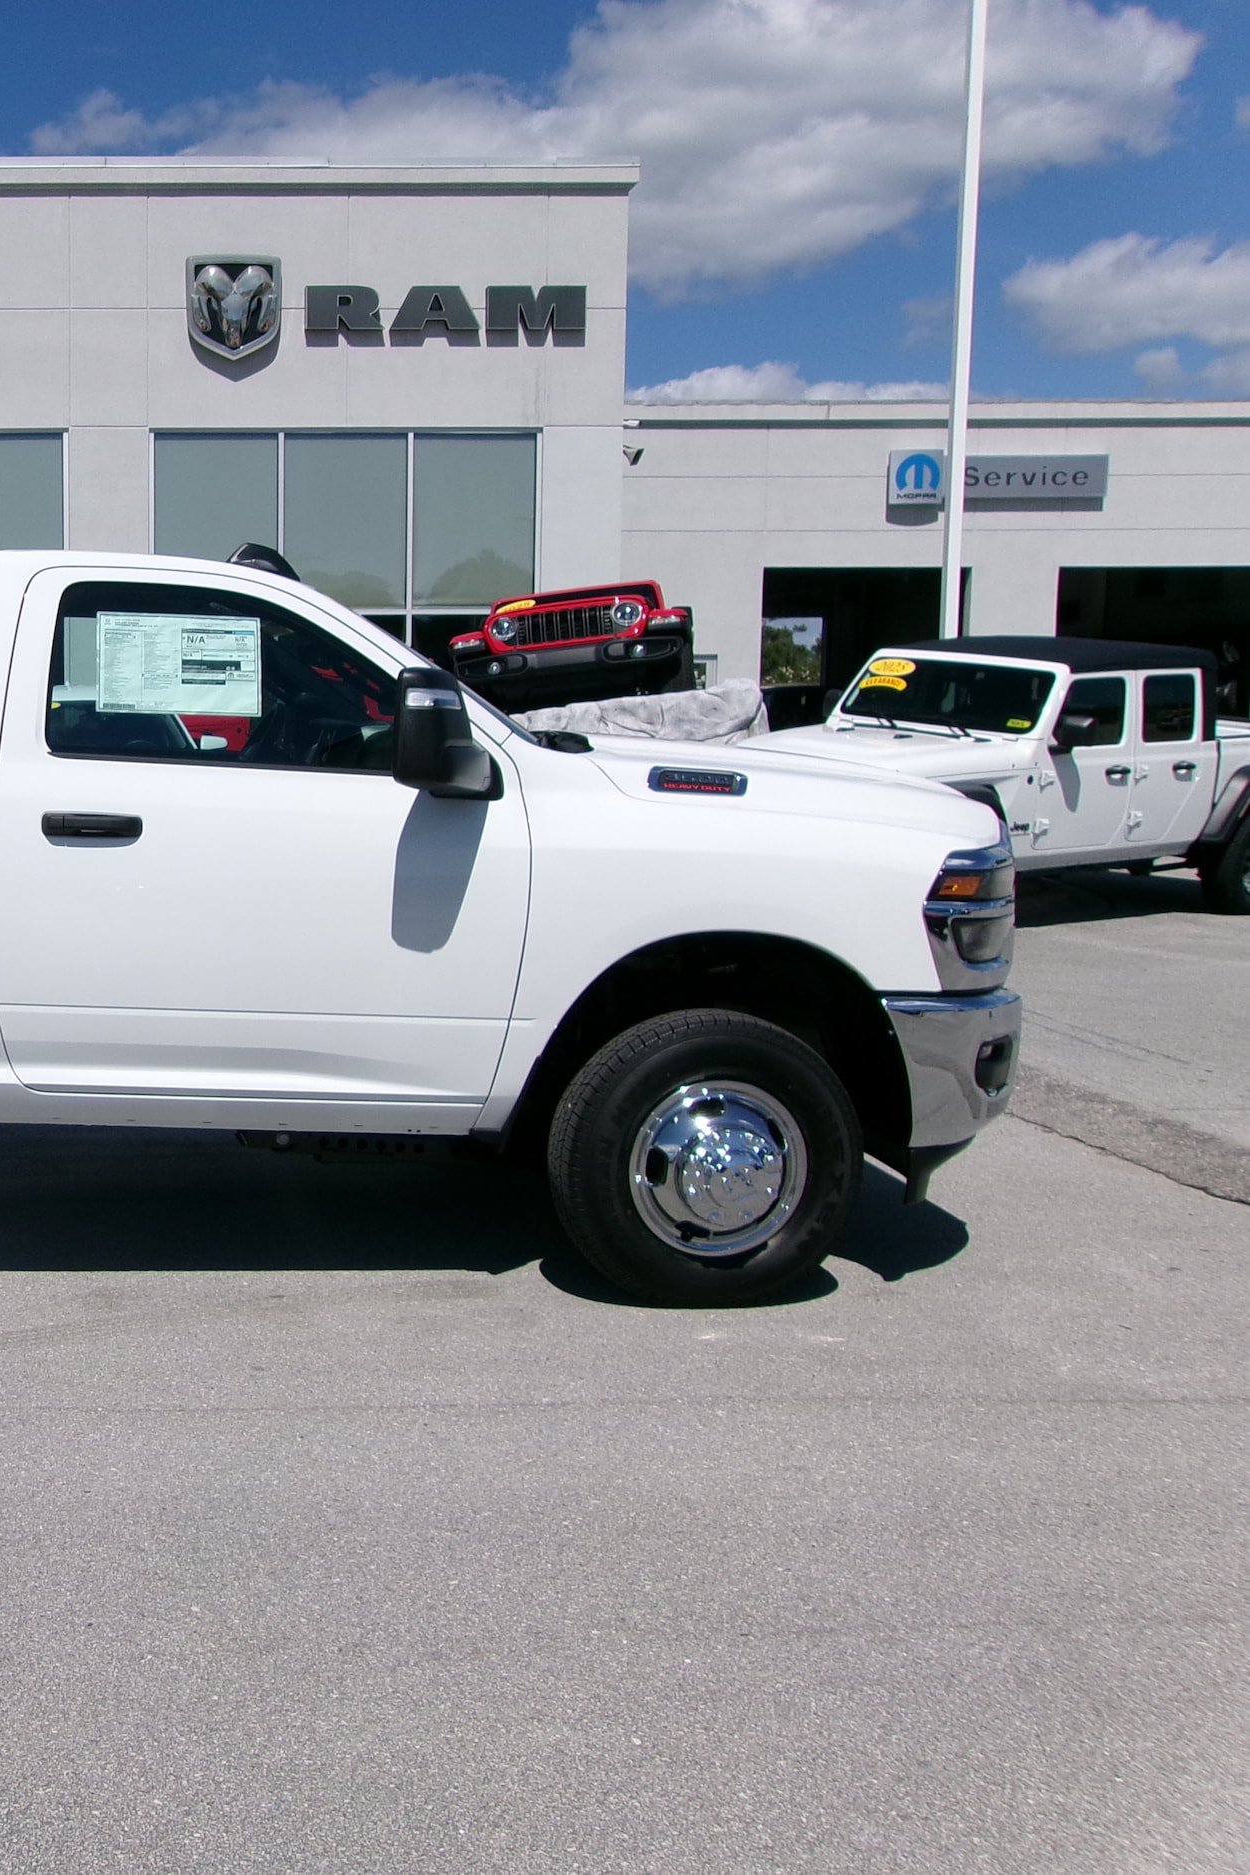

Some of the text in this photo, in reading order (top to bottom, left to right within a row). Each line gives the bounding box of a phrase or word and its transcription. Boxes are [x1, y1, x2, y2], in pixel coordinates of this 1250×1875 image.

[304, 284, 588, 330] RAM
[964, 466, 1089, 487] Service
[187, 635, 206, 644] N/A
[1010, 822, 1030, 833] Jeep
